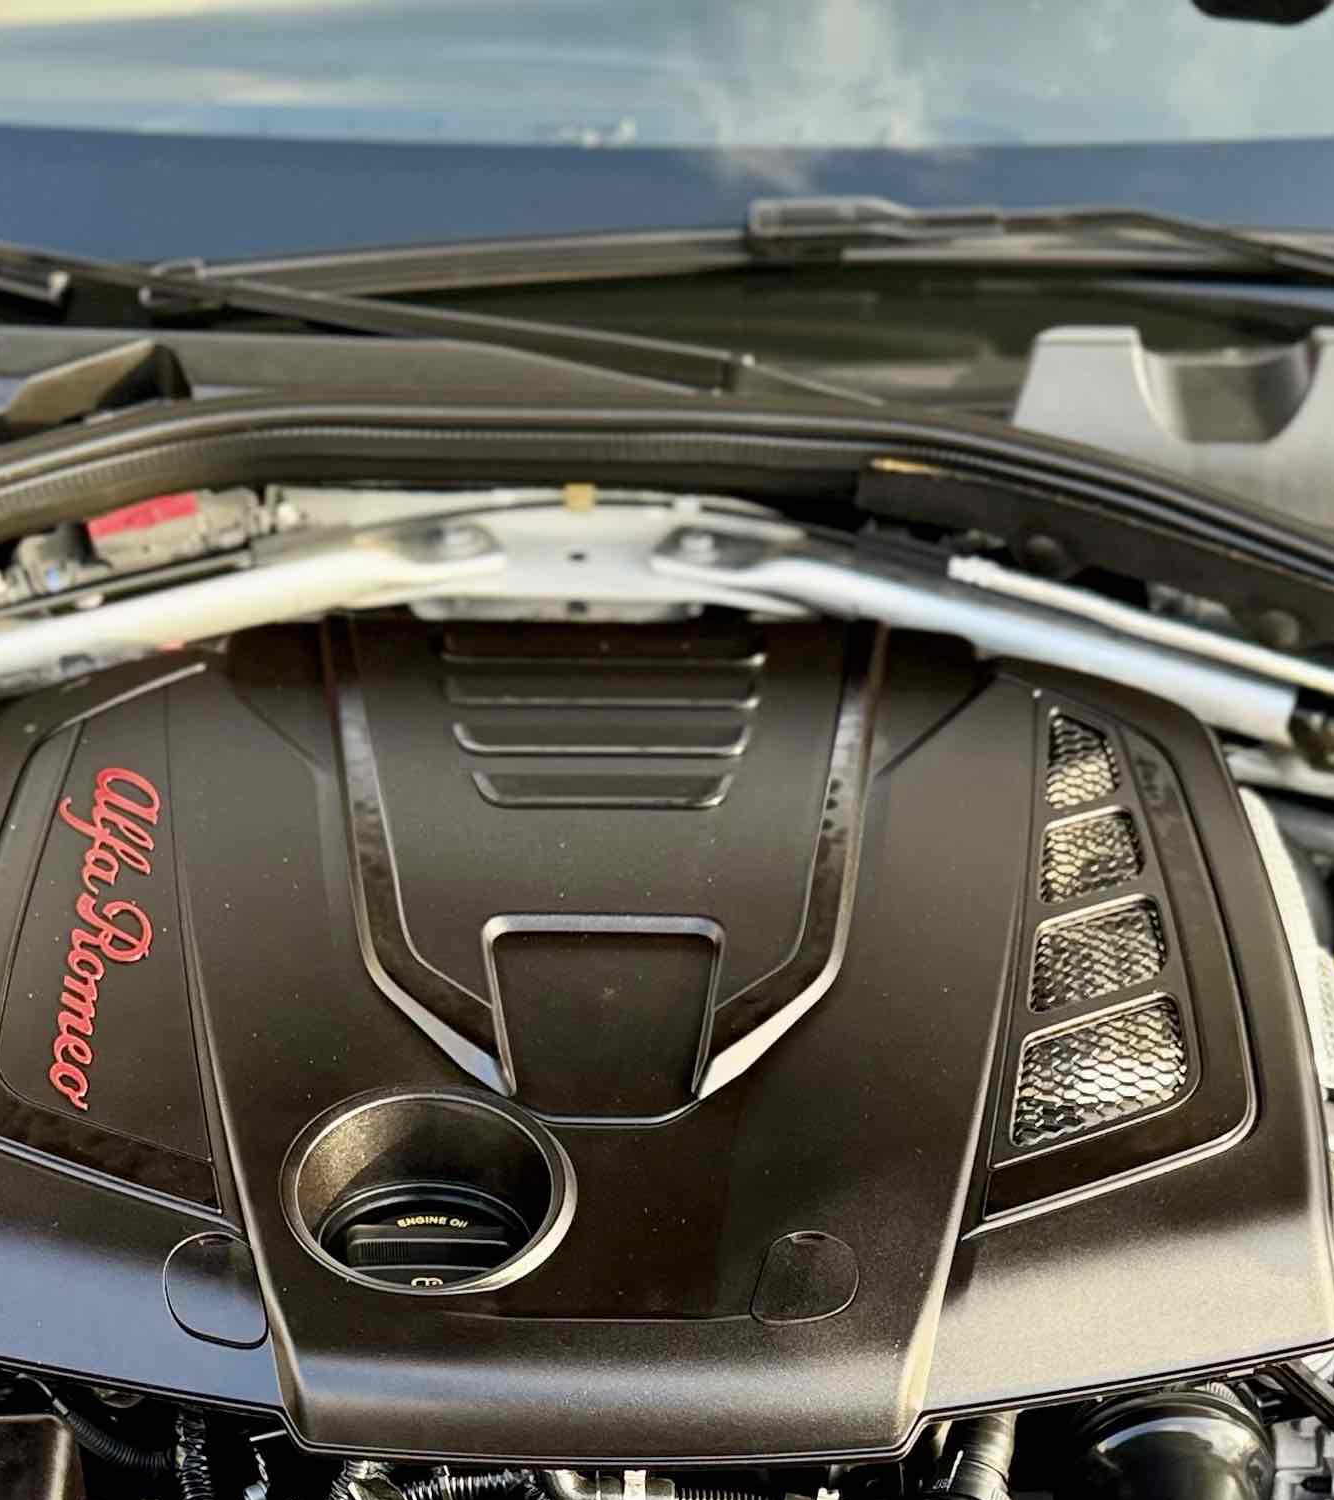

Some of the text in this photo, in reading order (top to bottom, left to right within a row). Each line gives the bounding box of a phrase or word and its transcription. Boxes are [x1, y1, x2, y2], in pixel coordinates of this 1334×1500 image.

[49, 768, 160, 1110] Alfa Romeo
[396, 1215, 447, 1228] ENGINE
